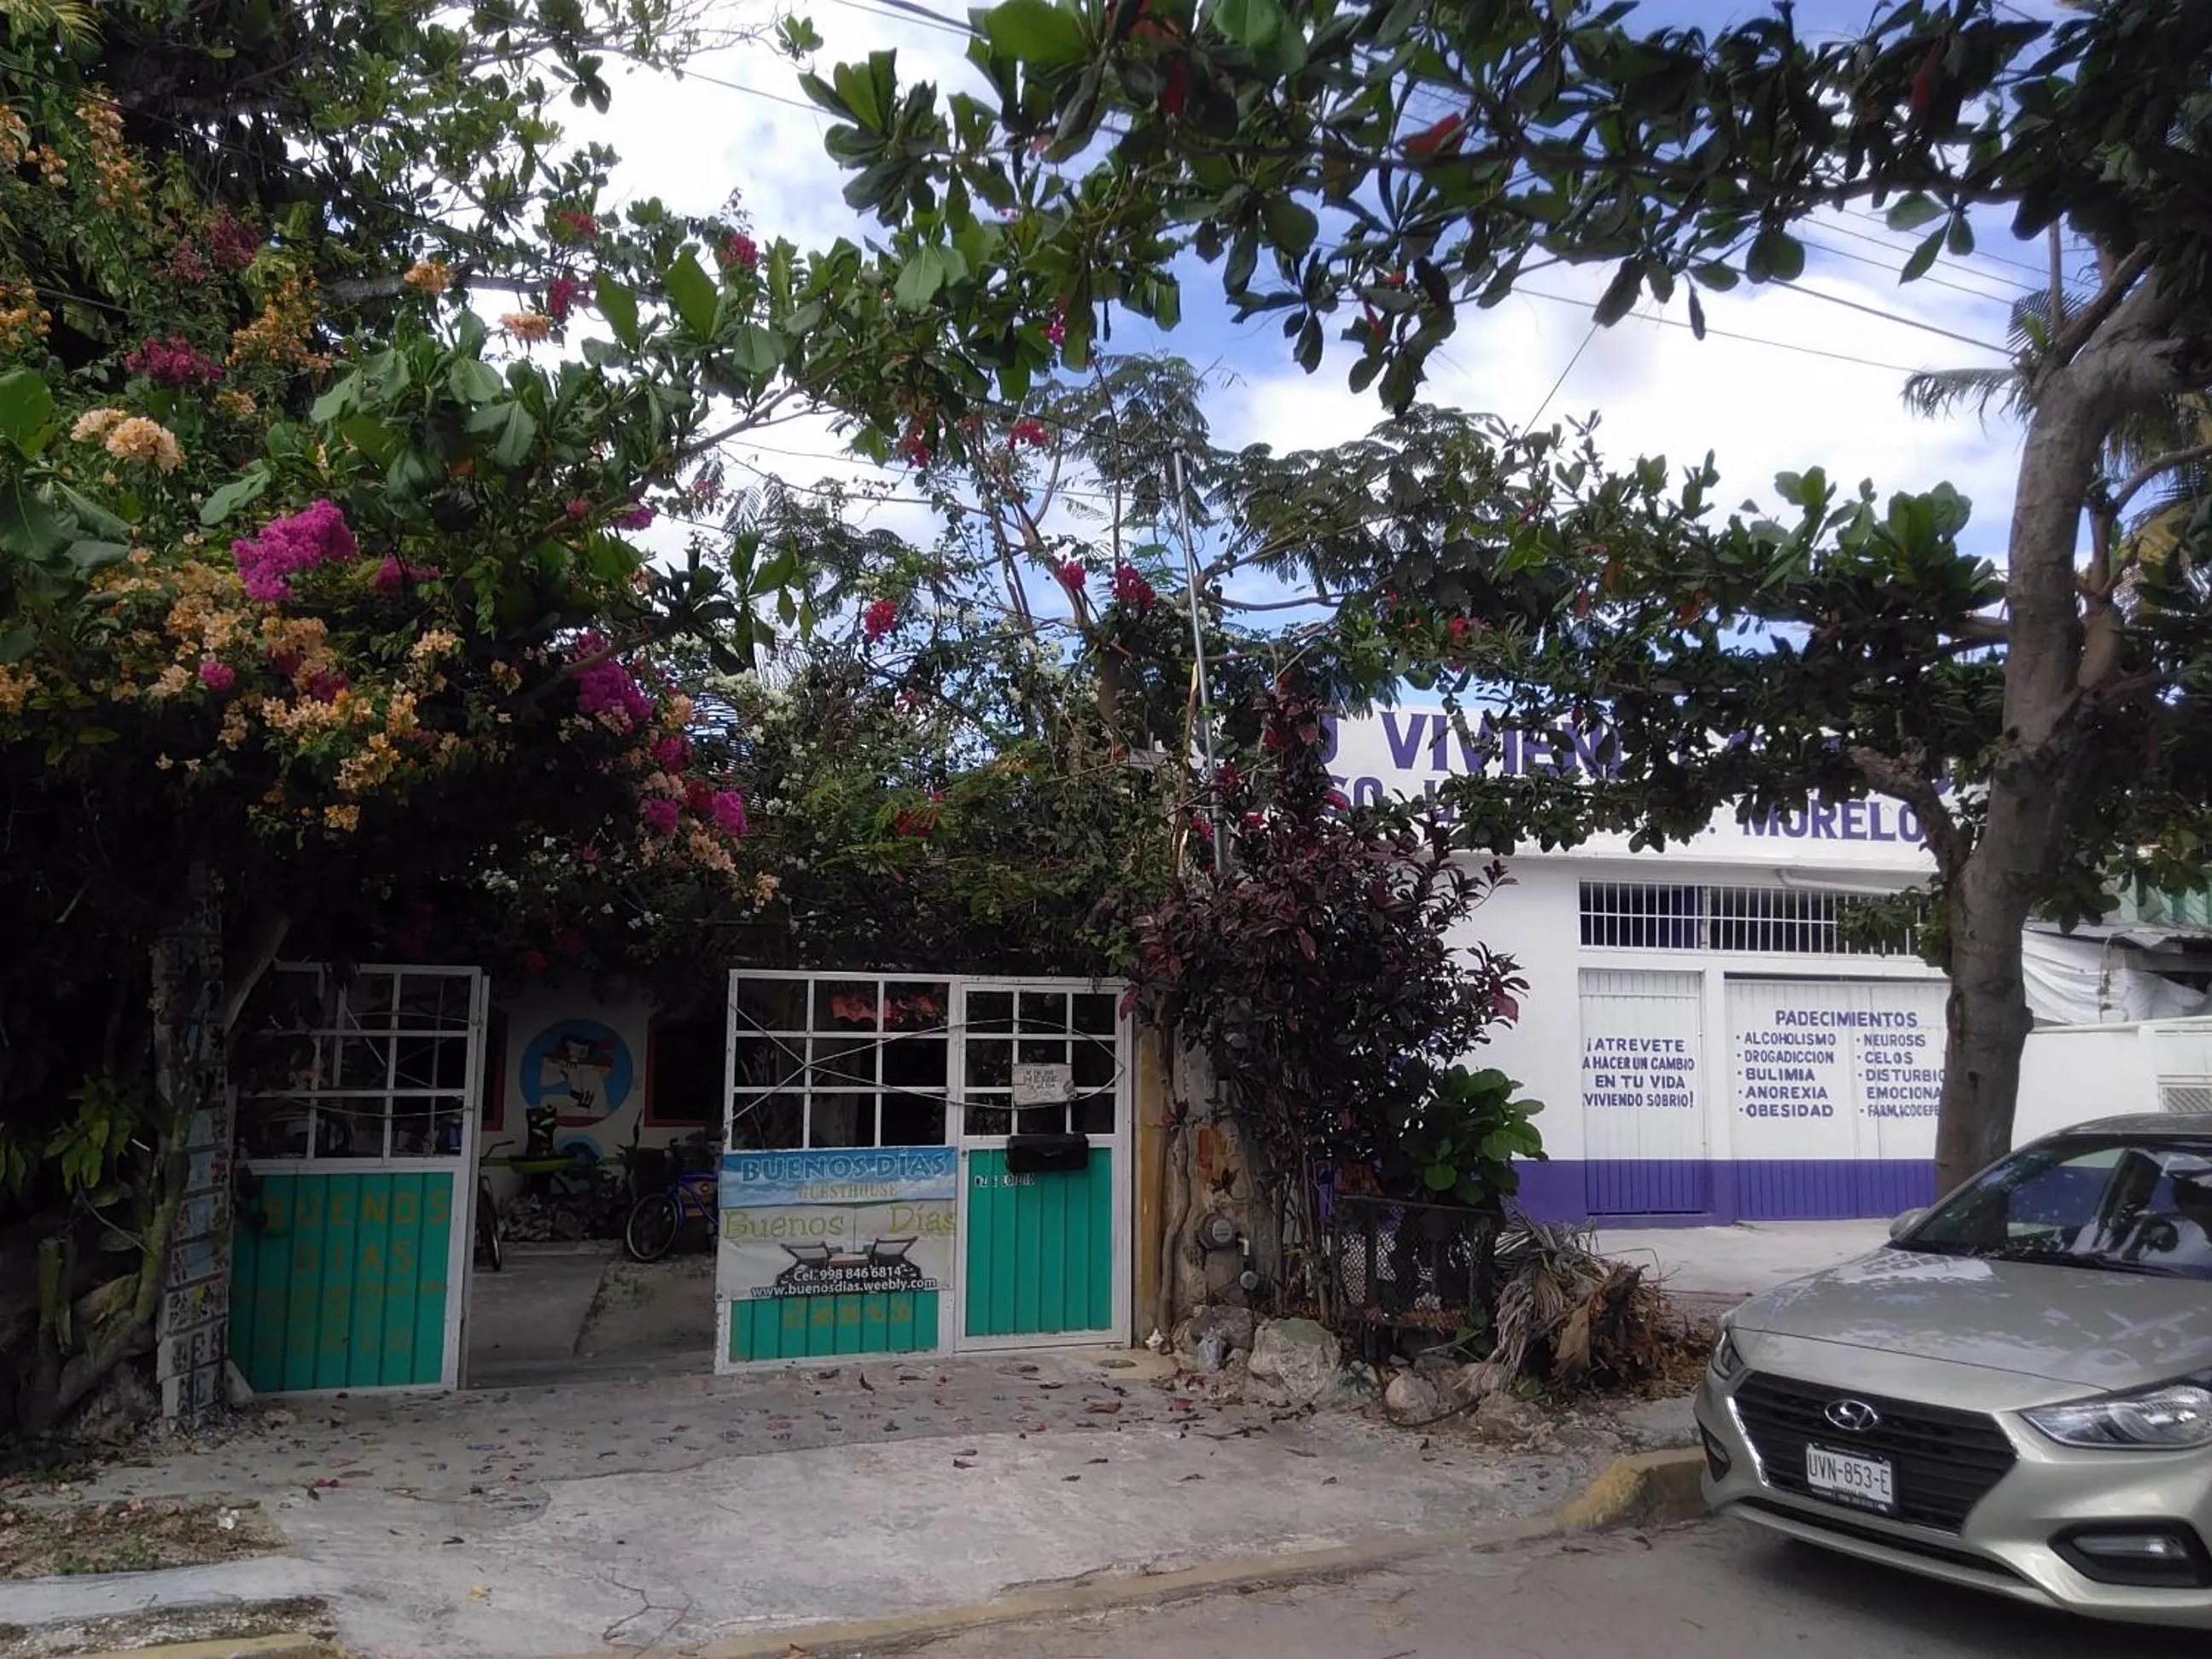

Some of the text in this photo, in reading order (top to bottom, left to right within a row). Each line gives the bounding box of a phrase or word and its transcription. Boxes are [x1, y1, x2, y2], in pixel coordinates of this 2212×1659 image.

[1381, 711, 1623, 779] VIVIEN
[1743, 797, 1930, 847] MORELO
[1775, 1010, 1918, 1027] PADECIMIENTOS
[1587, 1038, 1685, 1052] ¡ATREVETE
[1743, 1032, 1837, 1045] ALCOHOLISMO
[1864, 1034, 1926, 1047] NEUROSIS
[1582, 1056, 1695, 1071] A HACER UN CAMBIO
[1744, 1050, 1834, 1063] DROGADICCION
[1865, 1051, 1913, 1064] CELOS
[1595, 1074, 1685, 1089] EN TU VIDA
[1745, 1068, 1815, 1081] BULIMIA
[1646, 1091, 1694, 1109] SOBRIO!
[1745, 1086, 1828, 1099] ANOREXIA
[1745, 1103, 1834, 1117] OBESIDAD
[742, 1147, 947, 1182] BUENOS DÍAS
[797, 1183, 898, 1200] GUESTHOUSE
[724, 1203, 956, 1239] Buenos Días
[793, 1266, 901, 1282] Cel. 998 846 6814
[751, 1278, 938, 1297] www.buenosdias.weebly.com
[1808, 1452, 1890, 1496] UVN-853-E
